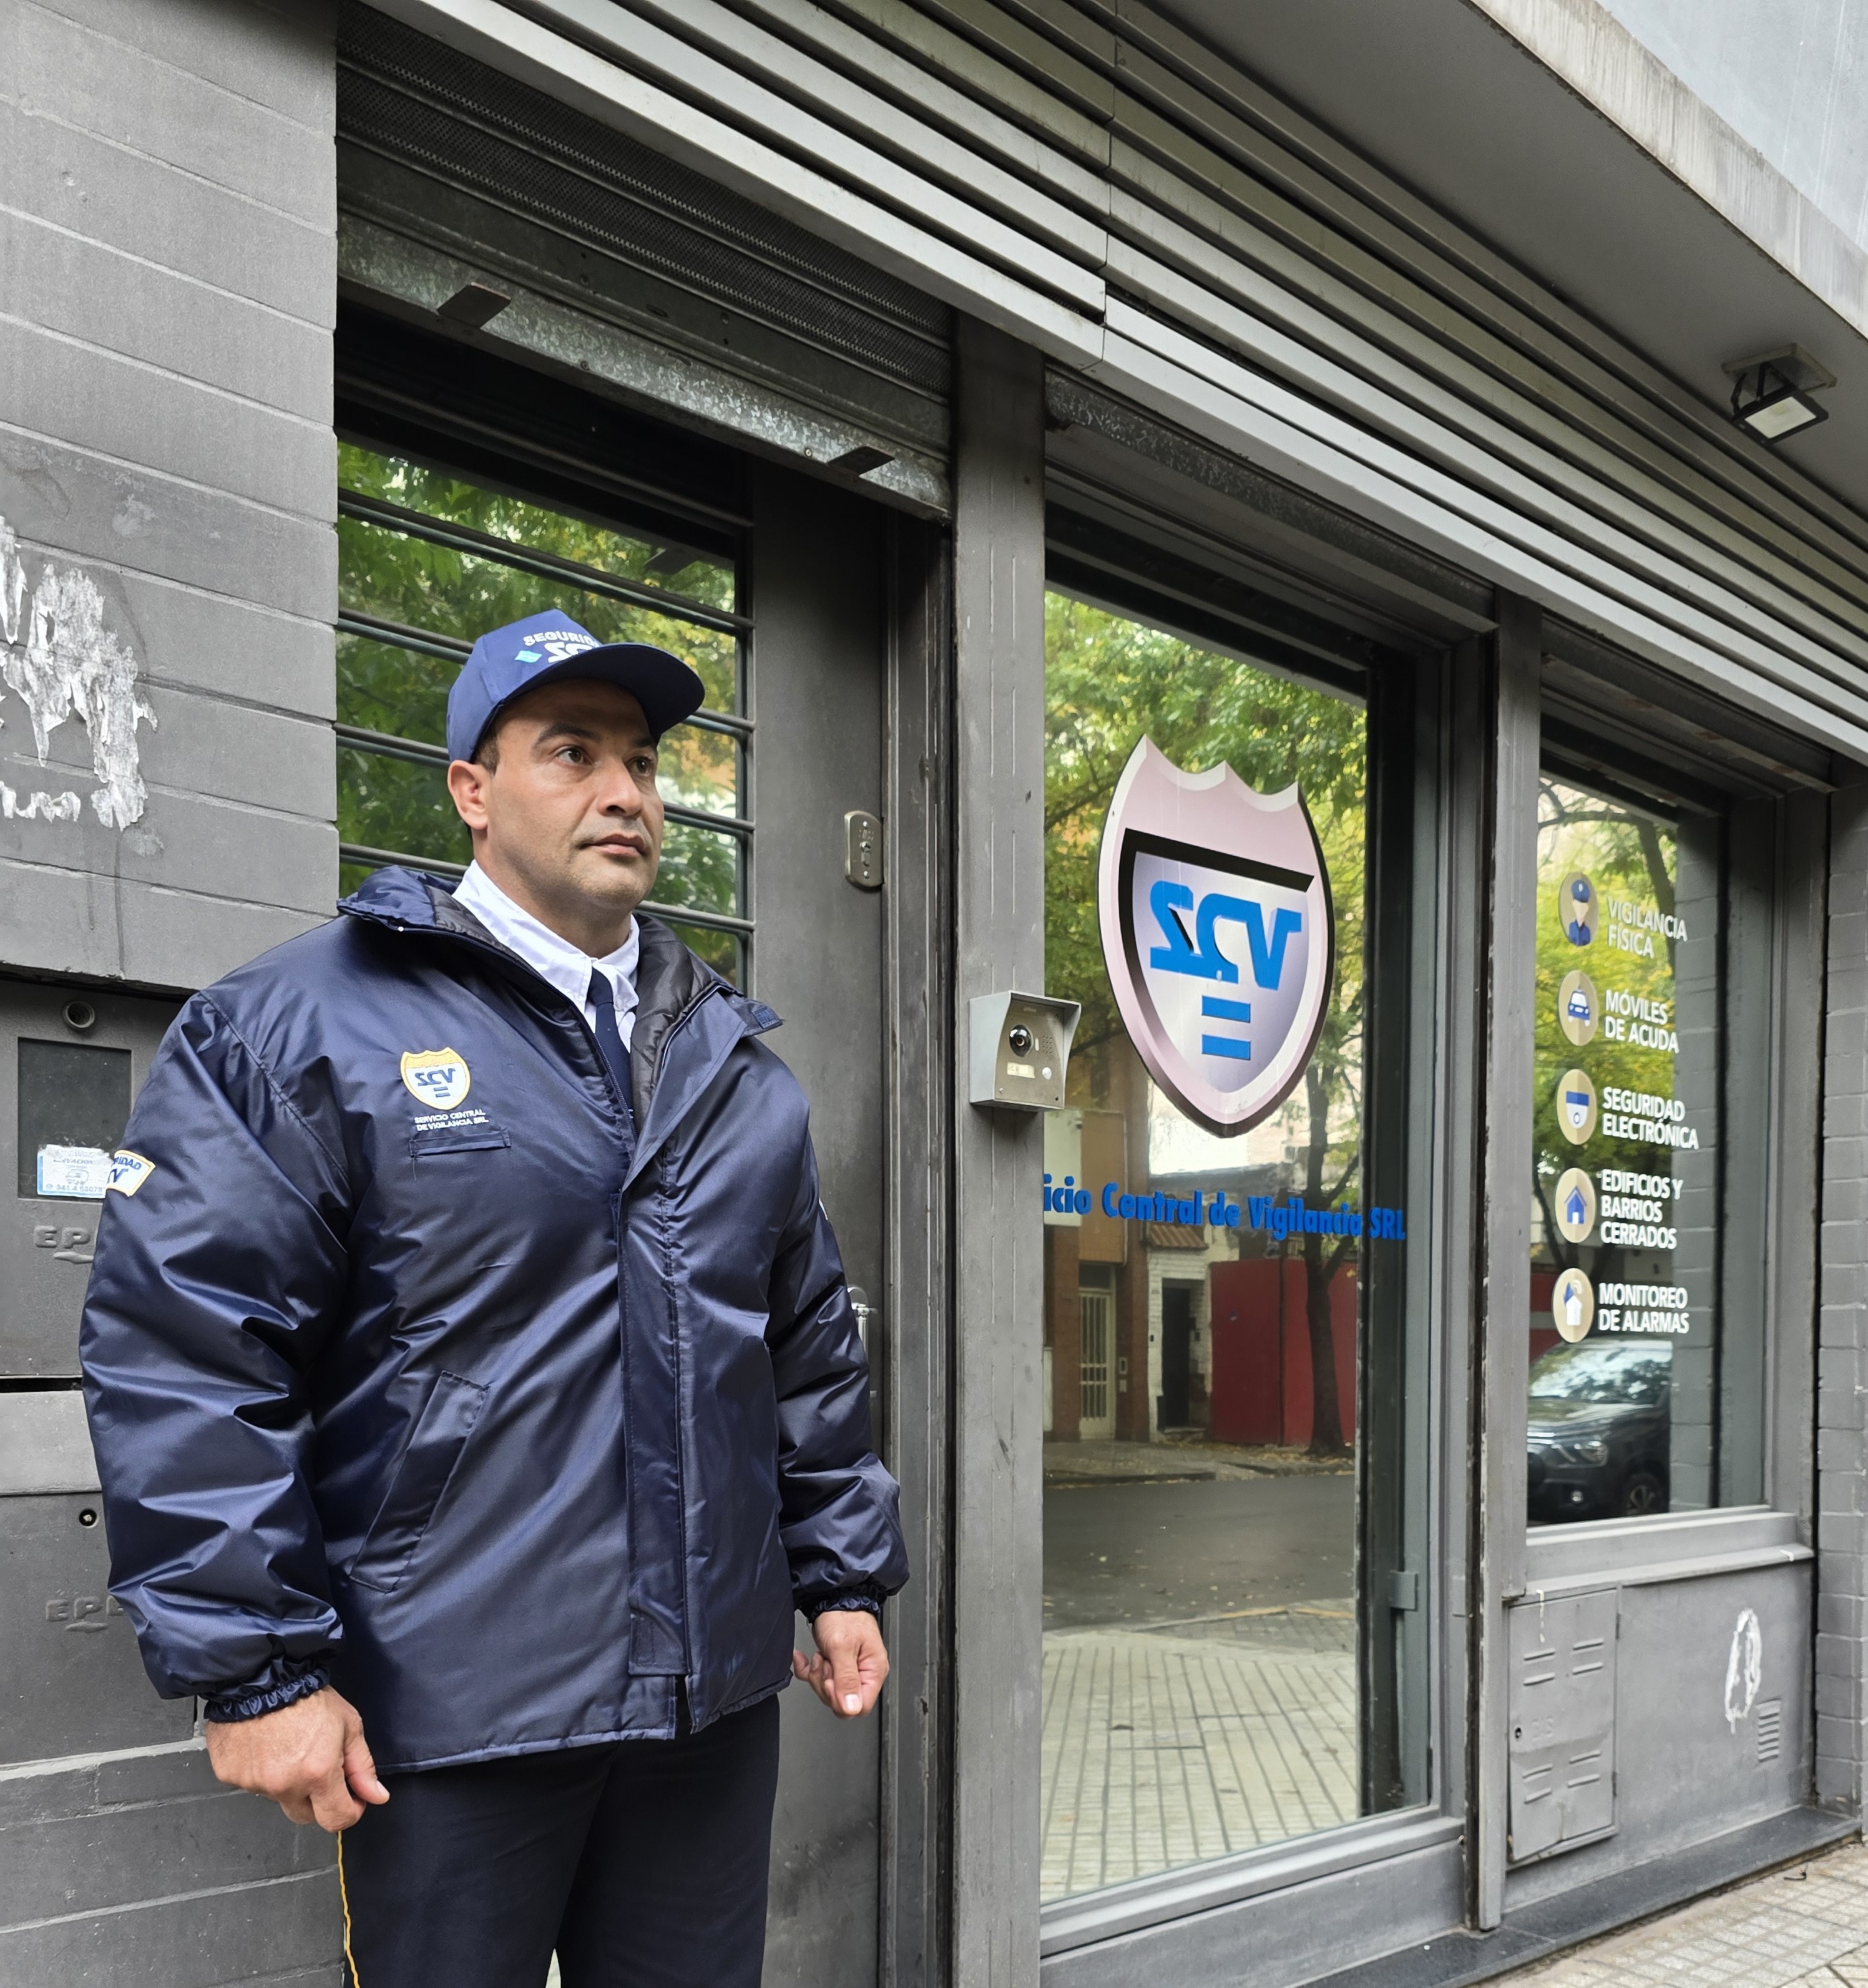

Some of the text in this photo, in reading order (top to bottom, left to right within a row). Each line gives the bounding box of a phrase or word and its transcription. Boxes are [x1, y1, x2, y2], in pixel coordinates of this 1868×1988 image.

[1150, 880, 1302, 990] SCV
[1608, 897, 1688, 942] VIGILANCIA
[1605, 988, 1668, 1025] MÓVILES
[1605, 1016, 1680, 1053] DE ACUDA
[415, 1068, 456, 1086] SCV
[414, 1109, 486, 1124] SERVICIO CENTRAL
[1603, 1086, 1685, 1122] SEGURIDAD
[428, 1119, 473, 1129] VIGILANCIA
[1603, 1113, 1698, 1150] ELECTRÓNICA
[1601, 1169, 1683, 1200] EDIFICIOS Y
[1102, 1182, 1202, 1225] Central
[1208, 1193, 1241, 1228] de
[1248, 1196, 1362, 1242] Vigilancia
[1369, 1207, 1406, 1240] SRL
[1601, 1195, 1662, 1223] BARRIOS
[1600, 1221, 1677, 1249] CERRADOS
[1598, 1282, 1688, 1309] MONITOREO
[1598, 1309, 1689, 1334] DE ALARMAS
